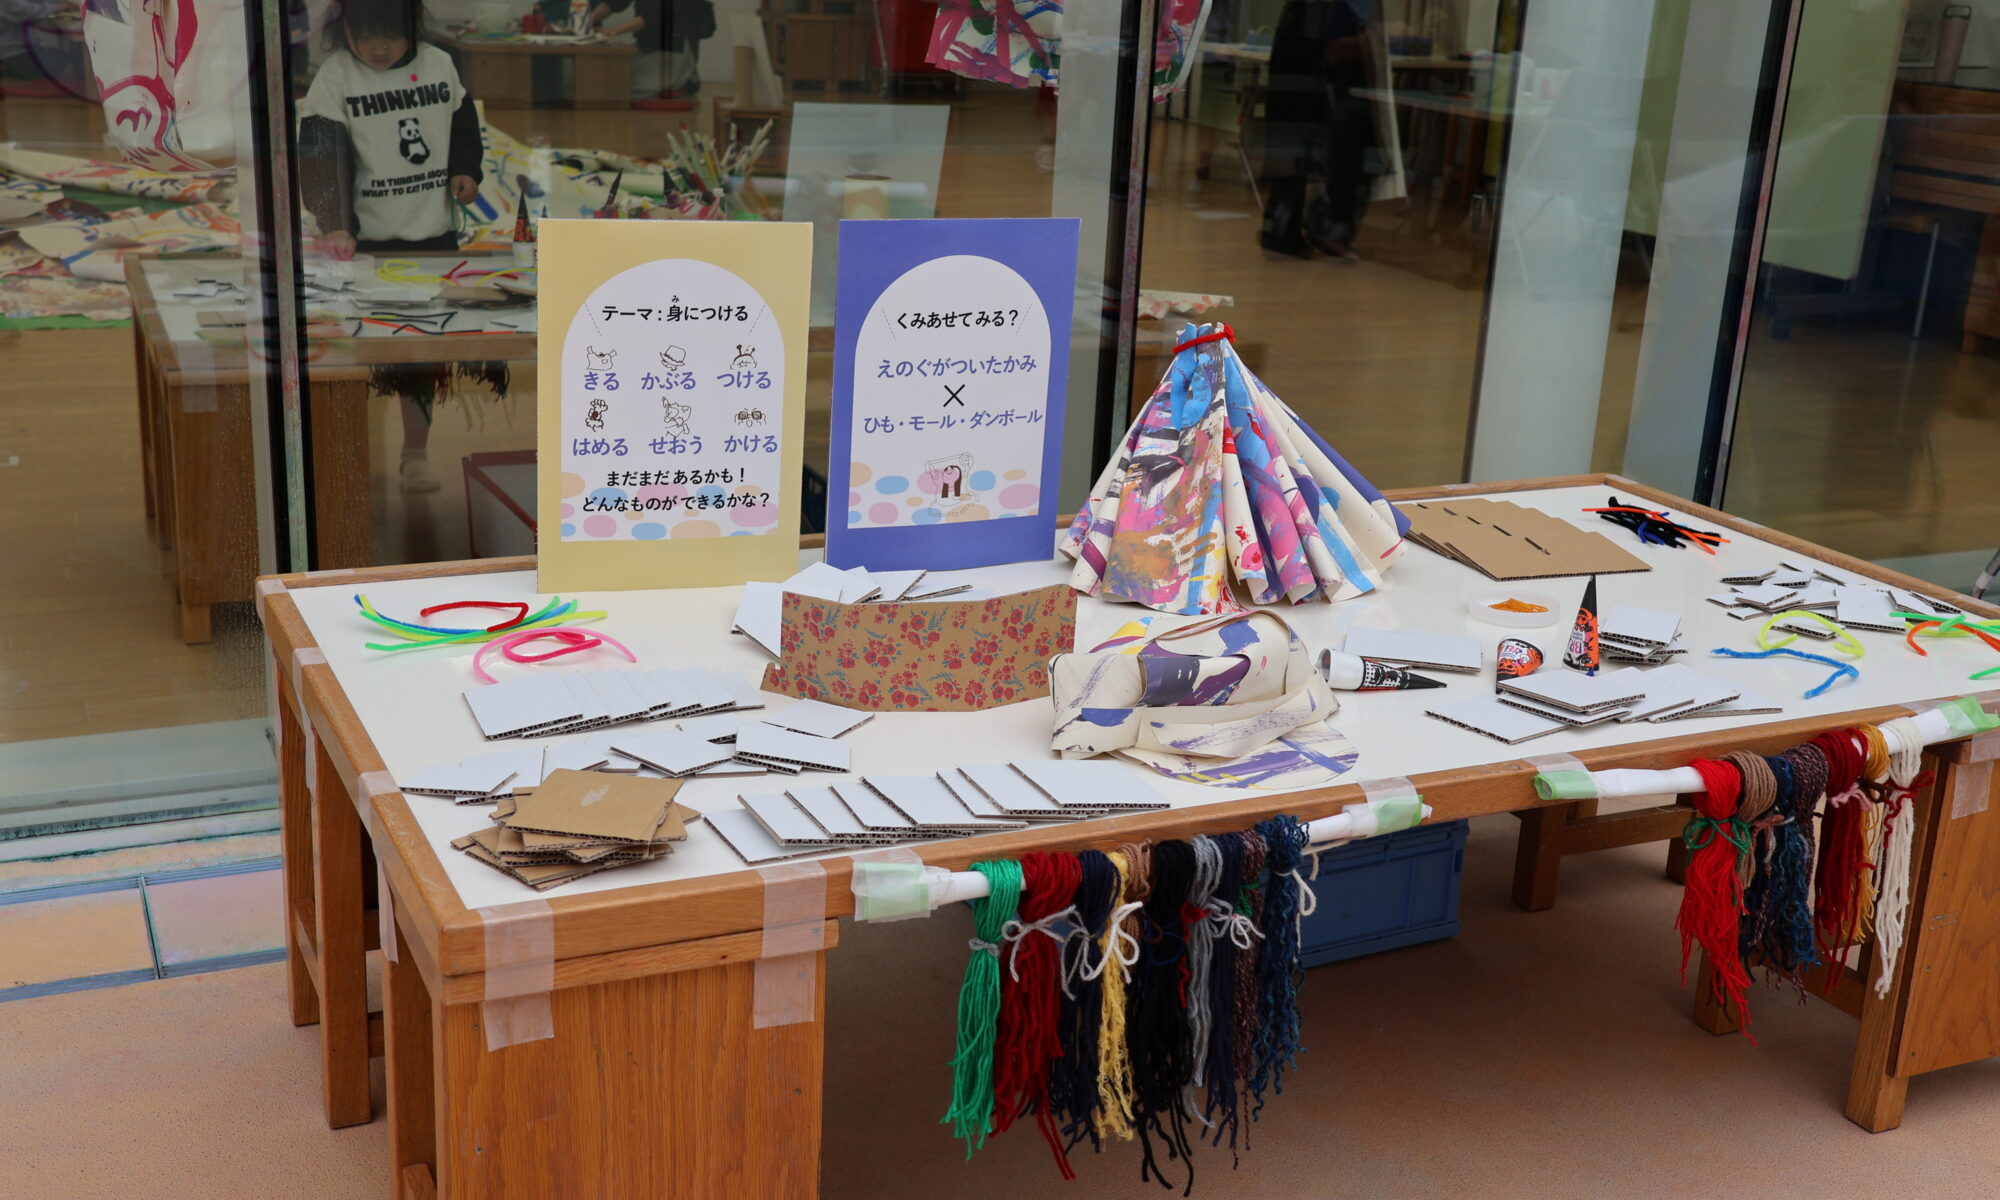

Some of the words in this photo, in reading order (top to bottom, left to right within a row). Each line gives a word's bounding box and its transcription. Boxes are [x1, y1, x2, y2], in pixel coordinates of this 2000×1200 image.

[346, 81, 450, 118] THINKING
[371, 178, 386, 188] I'M
[387, 172, 426, 187] THINKING
[427, 167, 450, 179] ABOU
[362, 188, 390, 198] WHAT
[391, 187, 405, 197] TO
[405, 184, 421, 194] EAT
[421, 180, 435, 191] FOR
[671, 295, 680, 303] み
[877, 354, 1038, 379] えのぐがついたかみ
[583, 371, 620, 391] きる
[641, 371, 697, 391] かぶる
[716, 369, 772, 390] つける
[864, 409, 1044, 434] ひも・モール・ダンボール
[572, 437, 629, 457] はめる
[648, 435, 703, 455] せおう
[724, 434, 779, 454] かける
